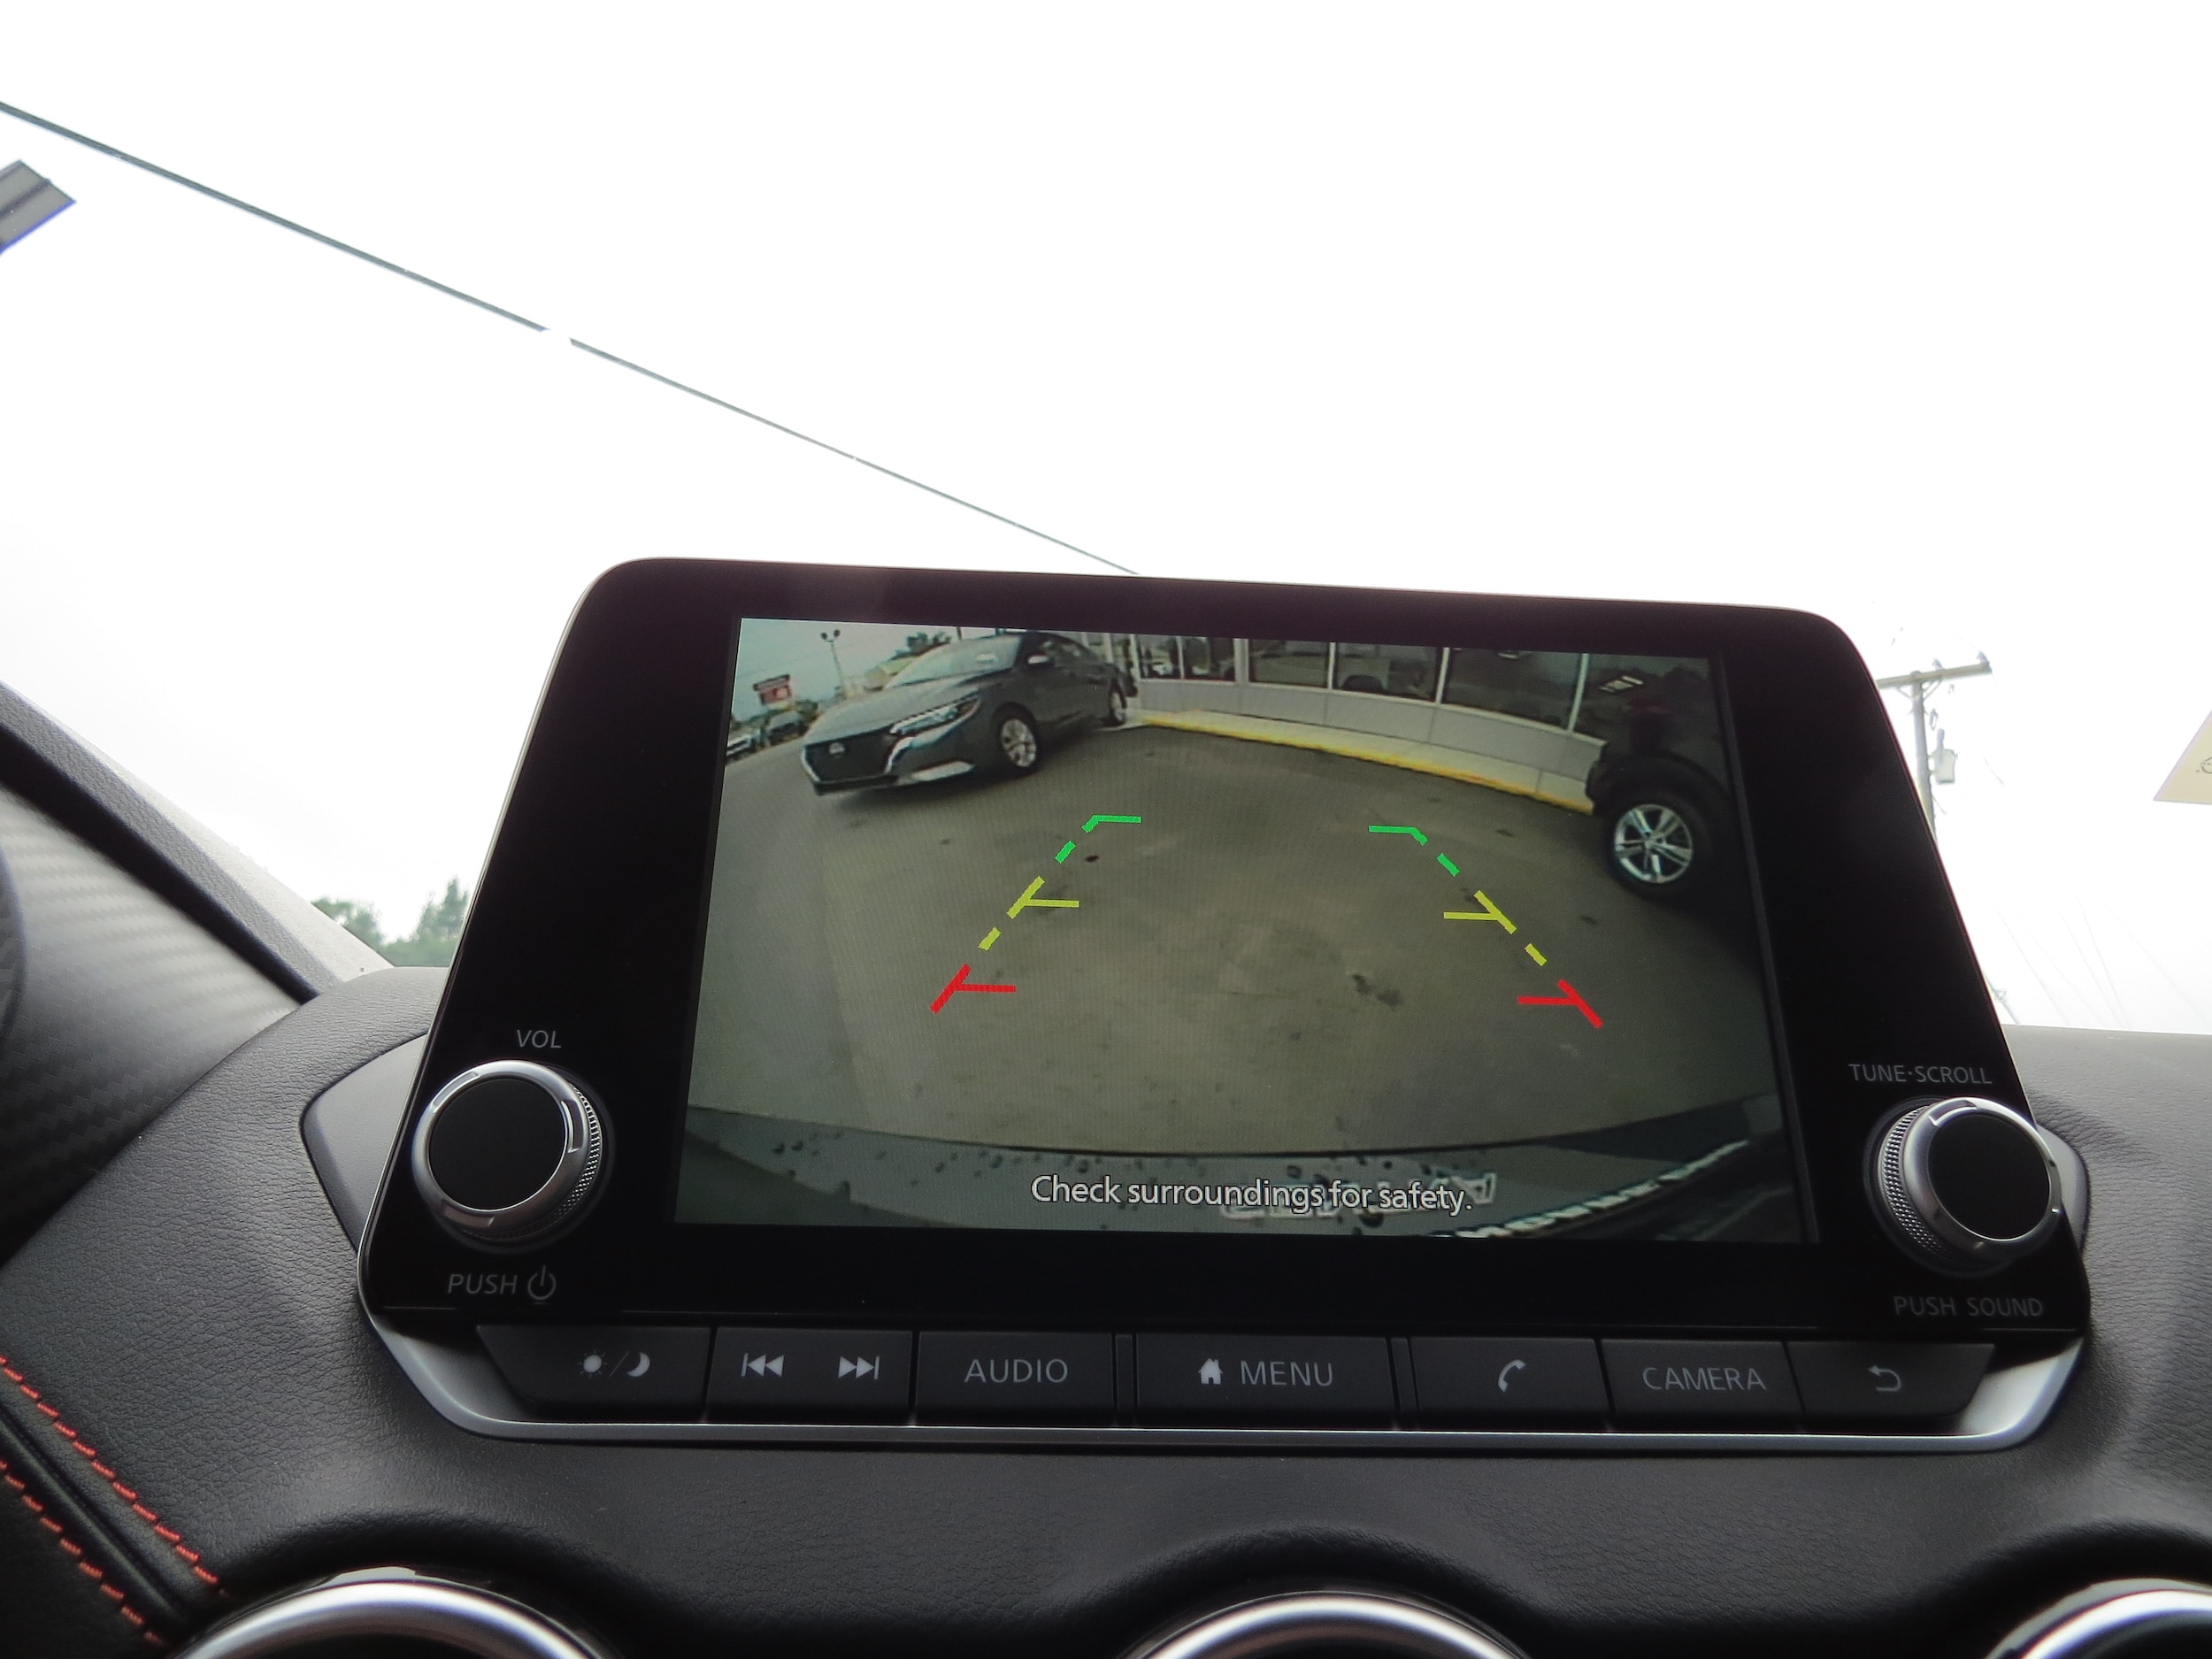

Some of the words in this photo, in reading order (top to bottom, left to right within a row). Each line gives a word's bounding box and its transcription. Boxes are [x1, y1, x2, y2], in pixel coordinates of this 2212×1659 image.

[516, 1029, 562, 1048] VOL
[1031, 1174, 1121, 1204] Check
[1128, 1179, 1324, 1215] surroundings
[1329, 1179, 1374, 1210] for
[1379, 1183, 1473, 1217] safety.
[448, 1274, 516, 1294] PUSH
[1893, 1296, 1957, 1316] PUSH
[1967, 1297, 2043, 1317] SOUND
[964, 1359, 1069, 1383] AUDIO
[1240, 1360, 1333, 1386] MENU
[1642, 1367, 1768, 1391] CAMERA
